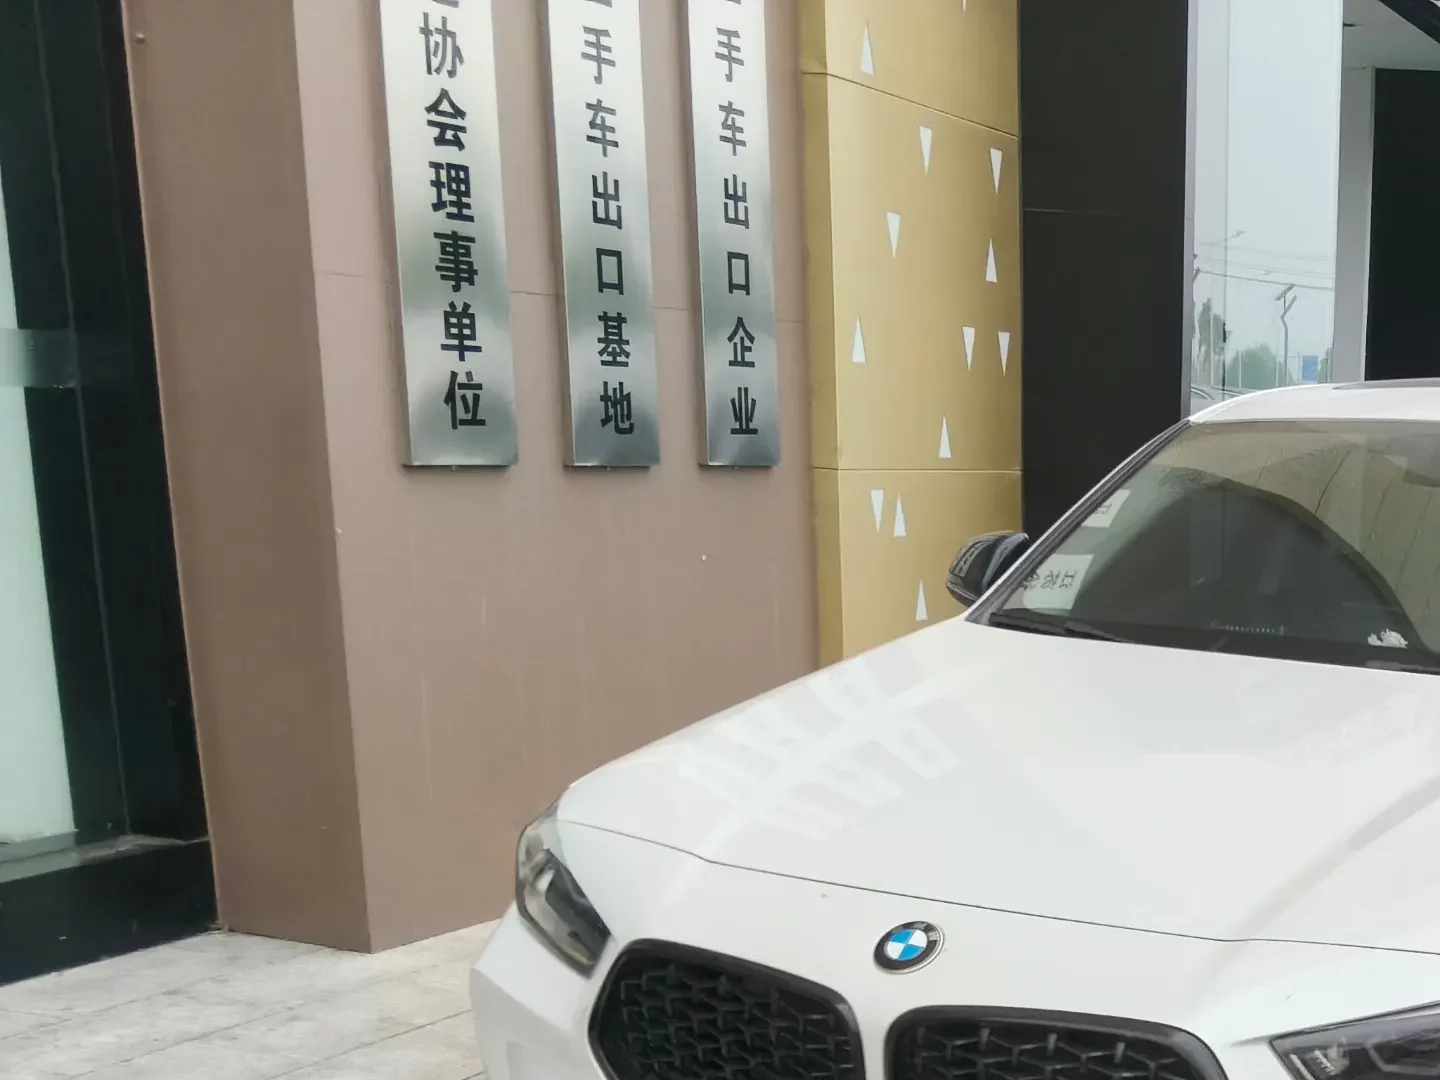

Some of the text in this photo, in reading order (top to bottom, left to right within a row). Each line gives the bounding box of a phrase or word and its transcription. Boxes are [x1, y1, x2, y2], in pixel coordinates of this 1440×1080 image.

[419, 0, 487, 430] 协会理事单位
[580, 0, 634, 435] 手车出口基地
[714, 0, 758, 435] 手车出口企业
